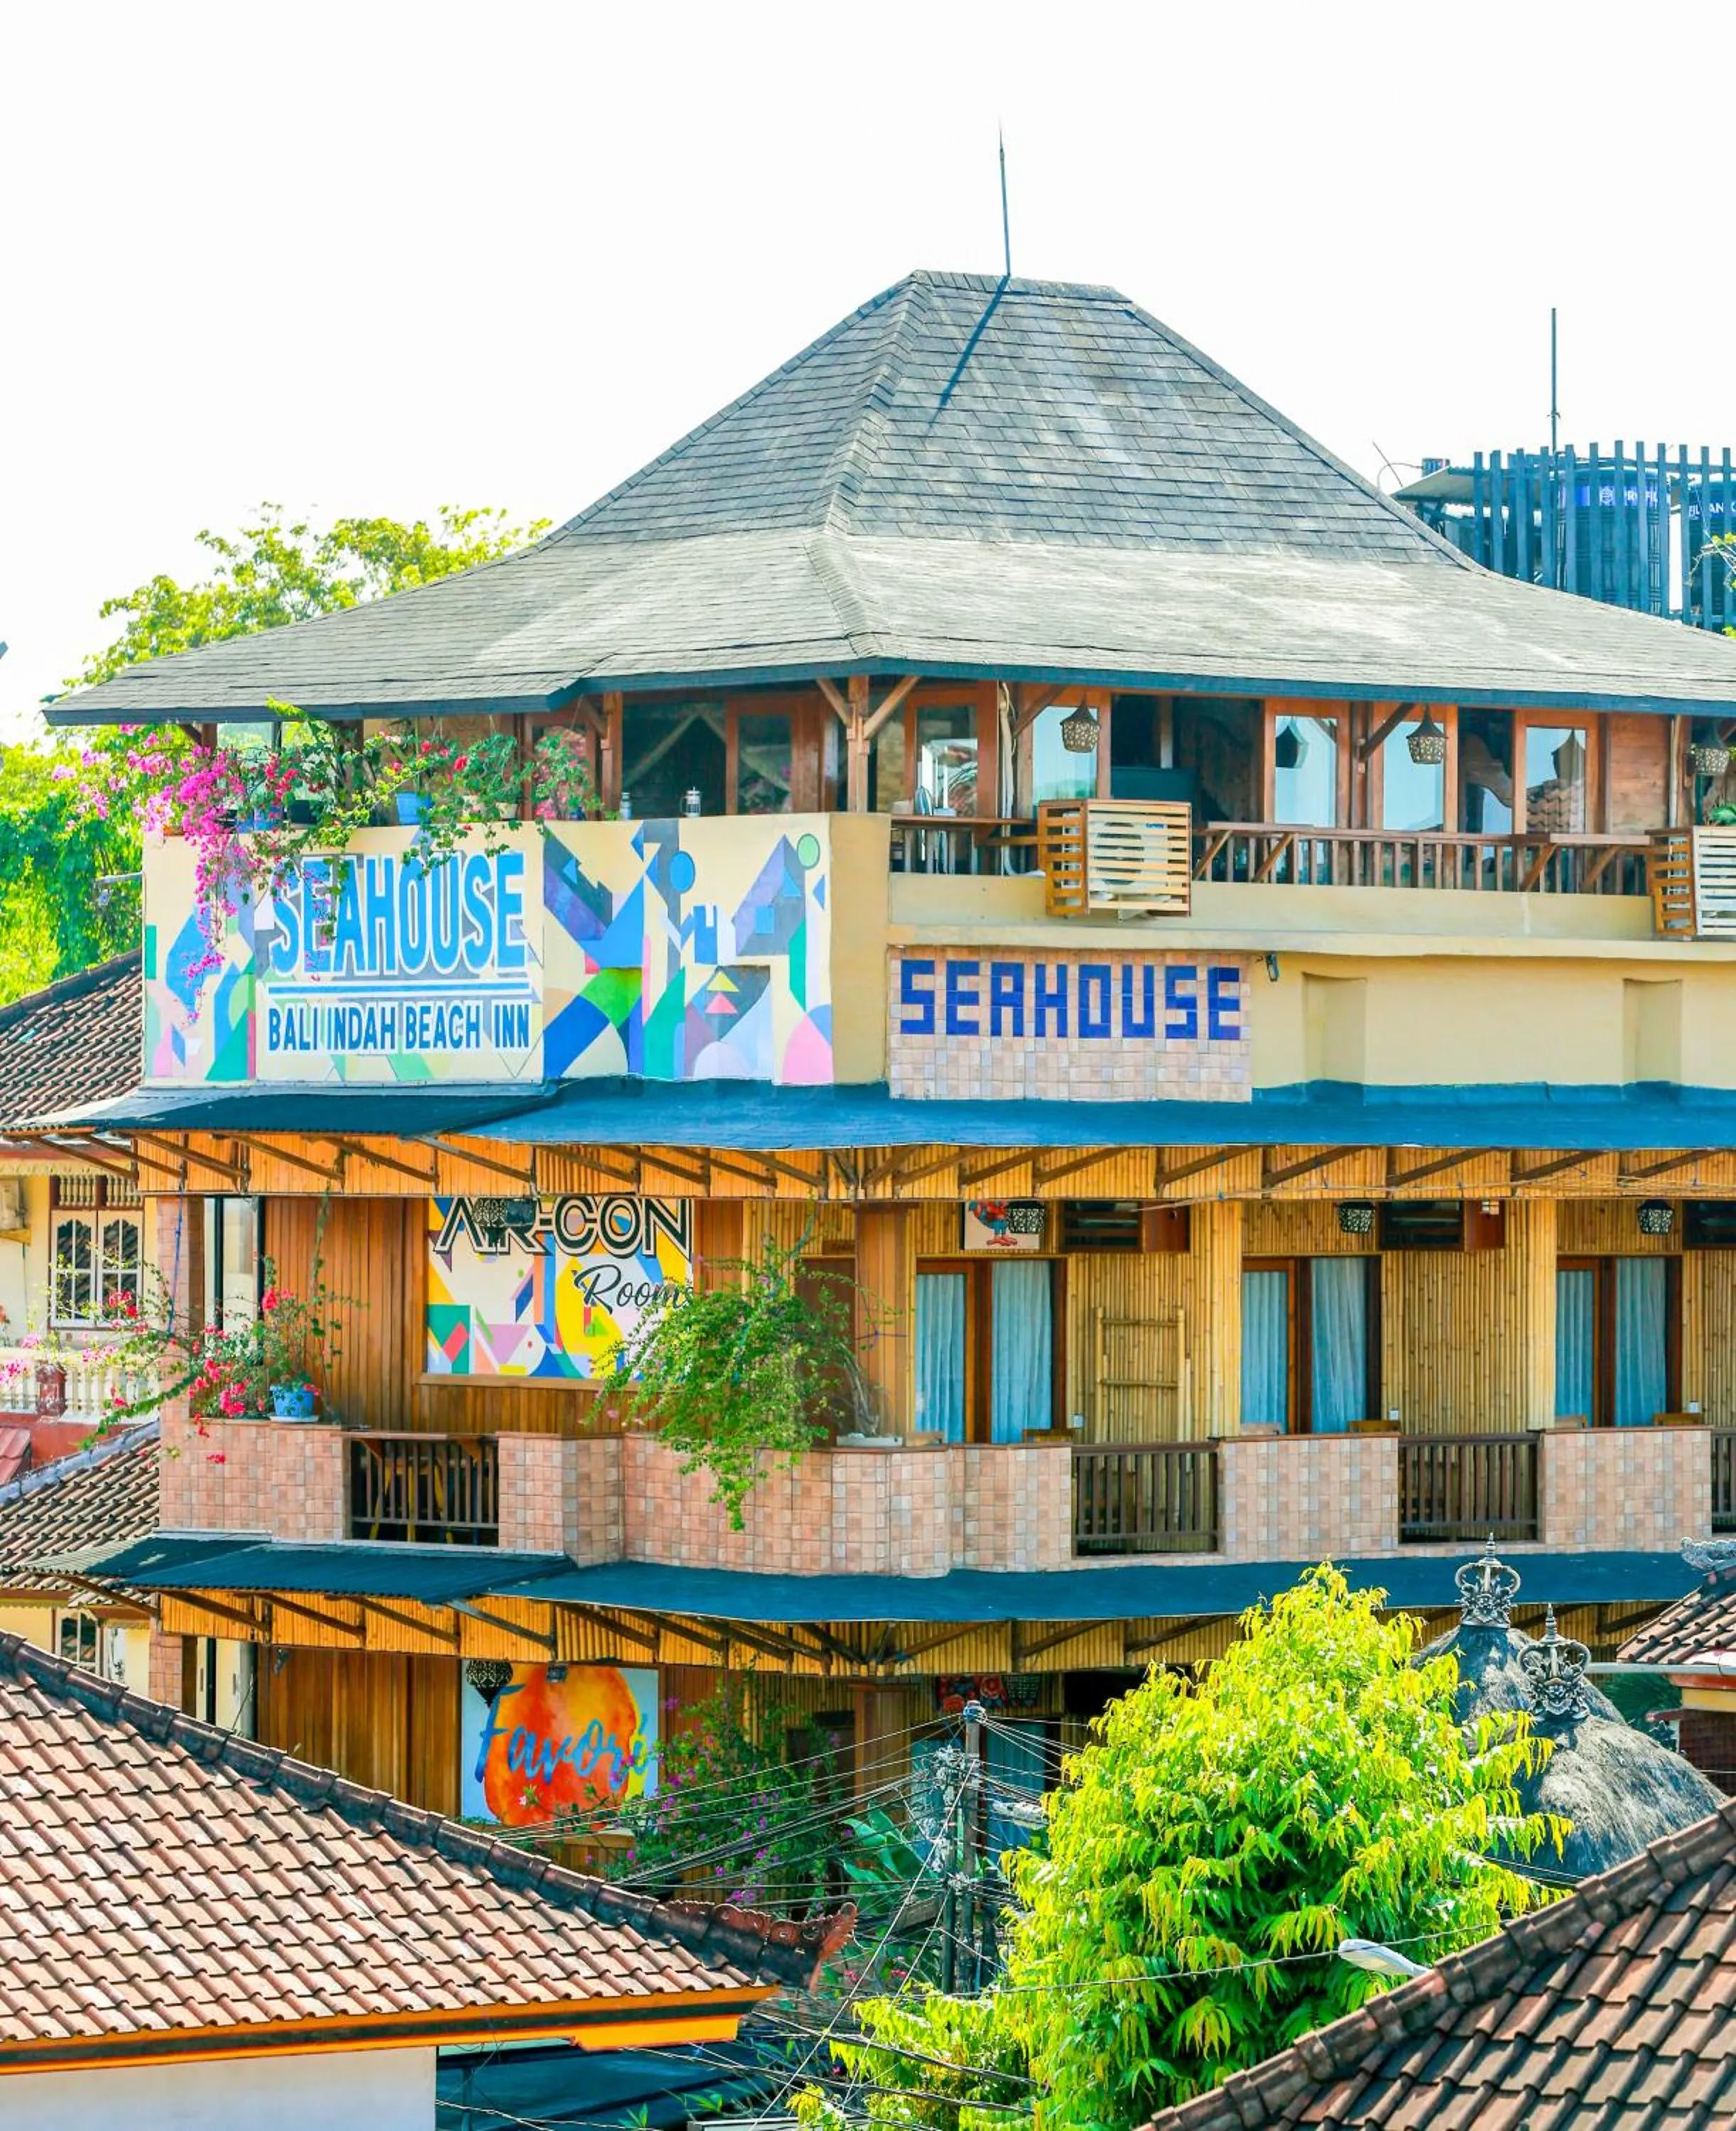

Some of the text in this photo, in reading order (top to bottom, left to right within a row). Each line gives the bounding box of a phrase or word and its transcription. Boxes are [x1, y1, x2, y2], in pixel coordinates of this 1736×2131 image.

[270, 852, 526, 975] SEAHOUSE
[268, 1003, 529, 1051] BALI INDAH BEACH INN
[901, 960, 1239, 1040] SEAHOUSE
